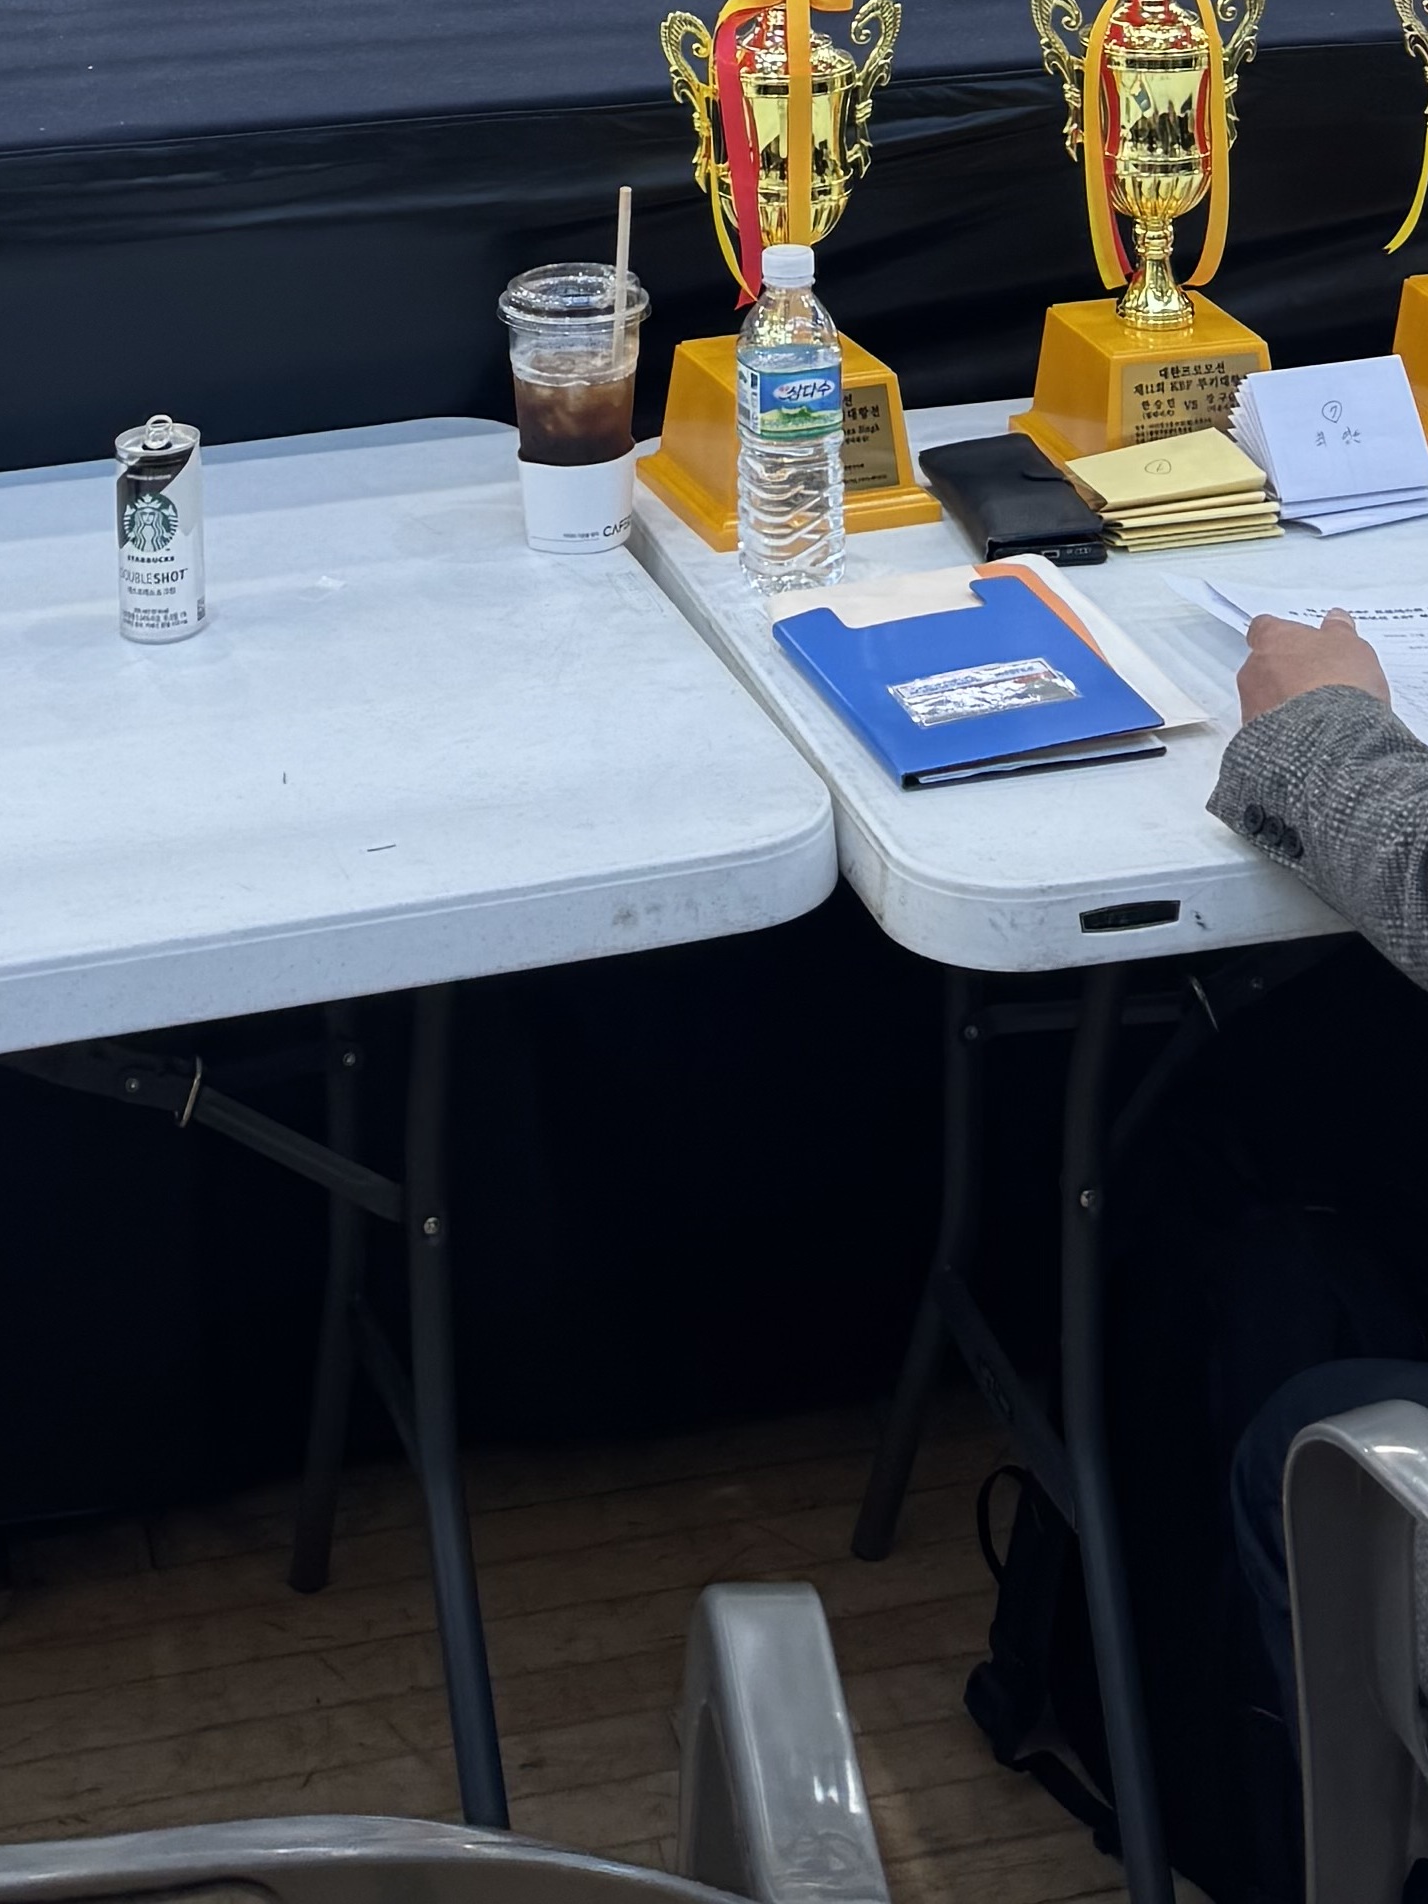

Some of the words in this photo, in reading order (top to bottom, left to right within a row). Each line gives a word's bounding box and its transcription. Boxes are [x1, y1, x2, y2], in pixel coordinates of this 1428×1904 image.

[787, 380, 832, 401] 삼다수
[1184, 400, 1199, 411] VS
[127, 555, 175, 564] STARBUCKS
